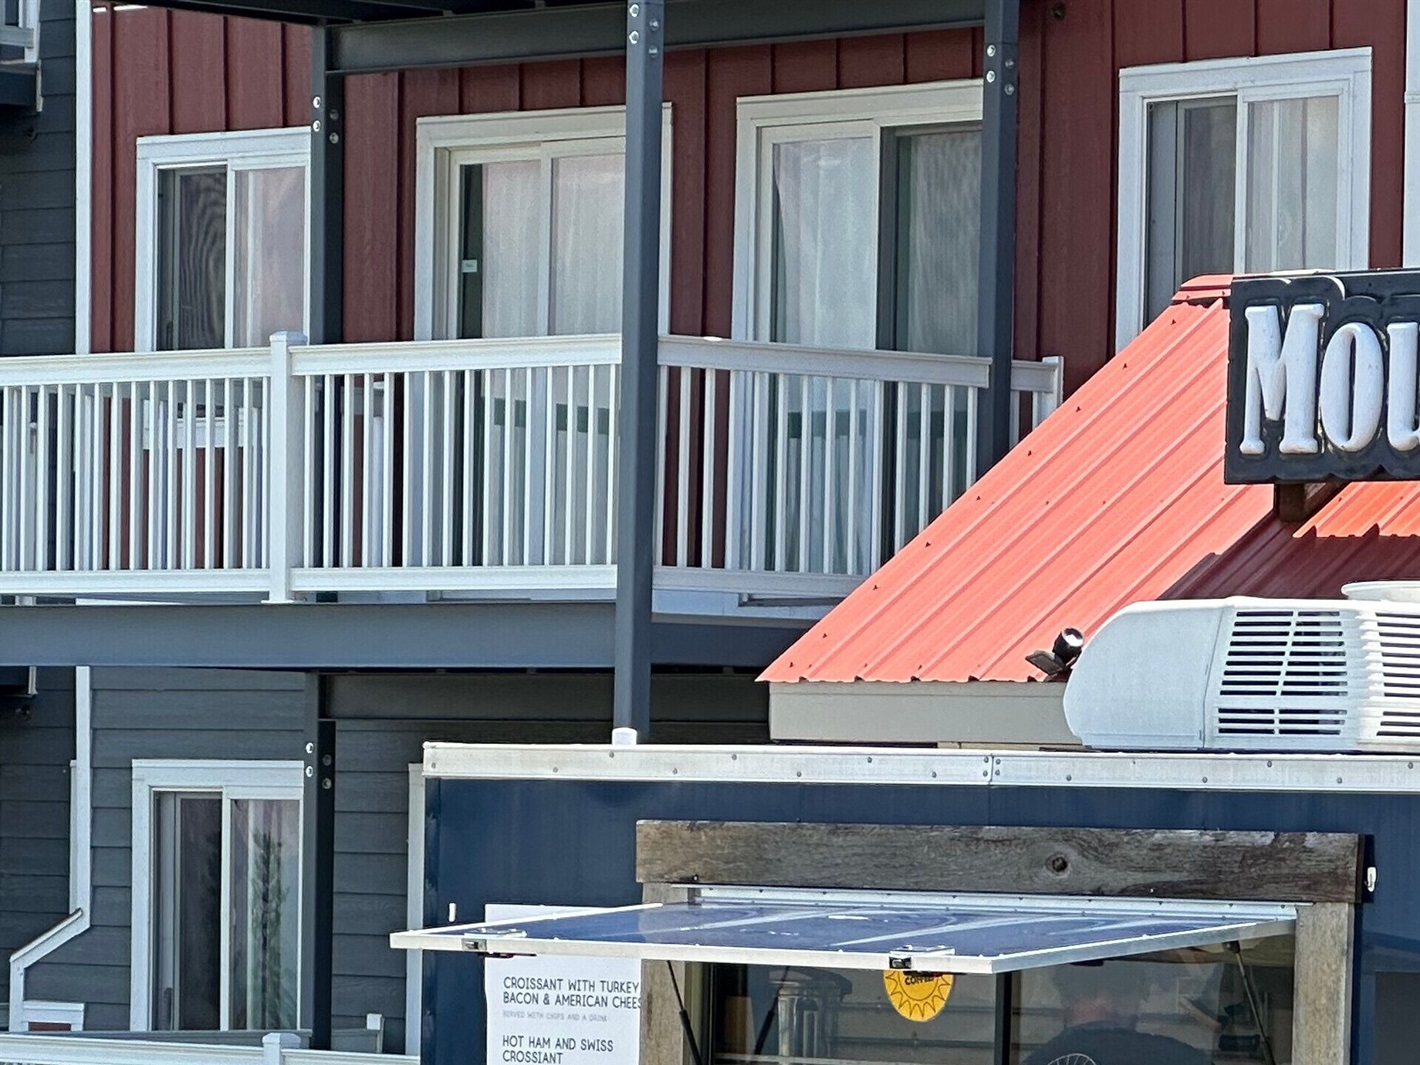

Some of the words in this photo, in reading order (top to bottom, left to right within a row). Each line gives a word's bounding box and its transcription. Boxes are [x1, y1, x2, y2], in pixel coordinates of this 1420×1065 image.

[504, 976, 563, 991] CROISSANT
[568, 979, 595, 992] WITH
[600, 980, 639, 994] TURKEY
[503, 992, 539, 1005] BACON
[543, 994, 550, 1005] &
[554, 994, 608, 1007] AMERICAN
[568, 1013, 580, 1021] AND
[502, 1036, 524, 1048] HOT
[529, 1036, 550, 1049] HAM
[555, 1038, 576, 1050] AND
[581, 1039, 614, 1052] SWISS
[503, 1050, 563, 1064] CROSSIANT
